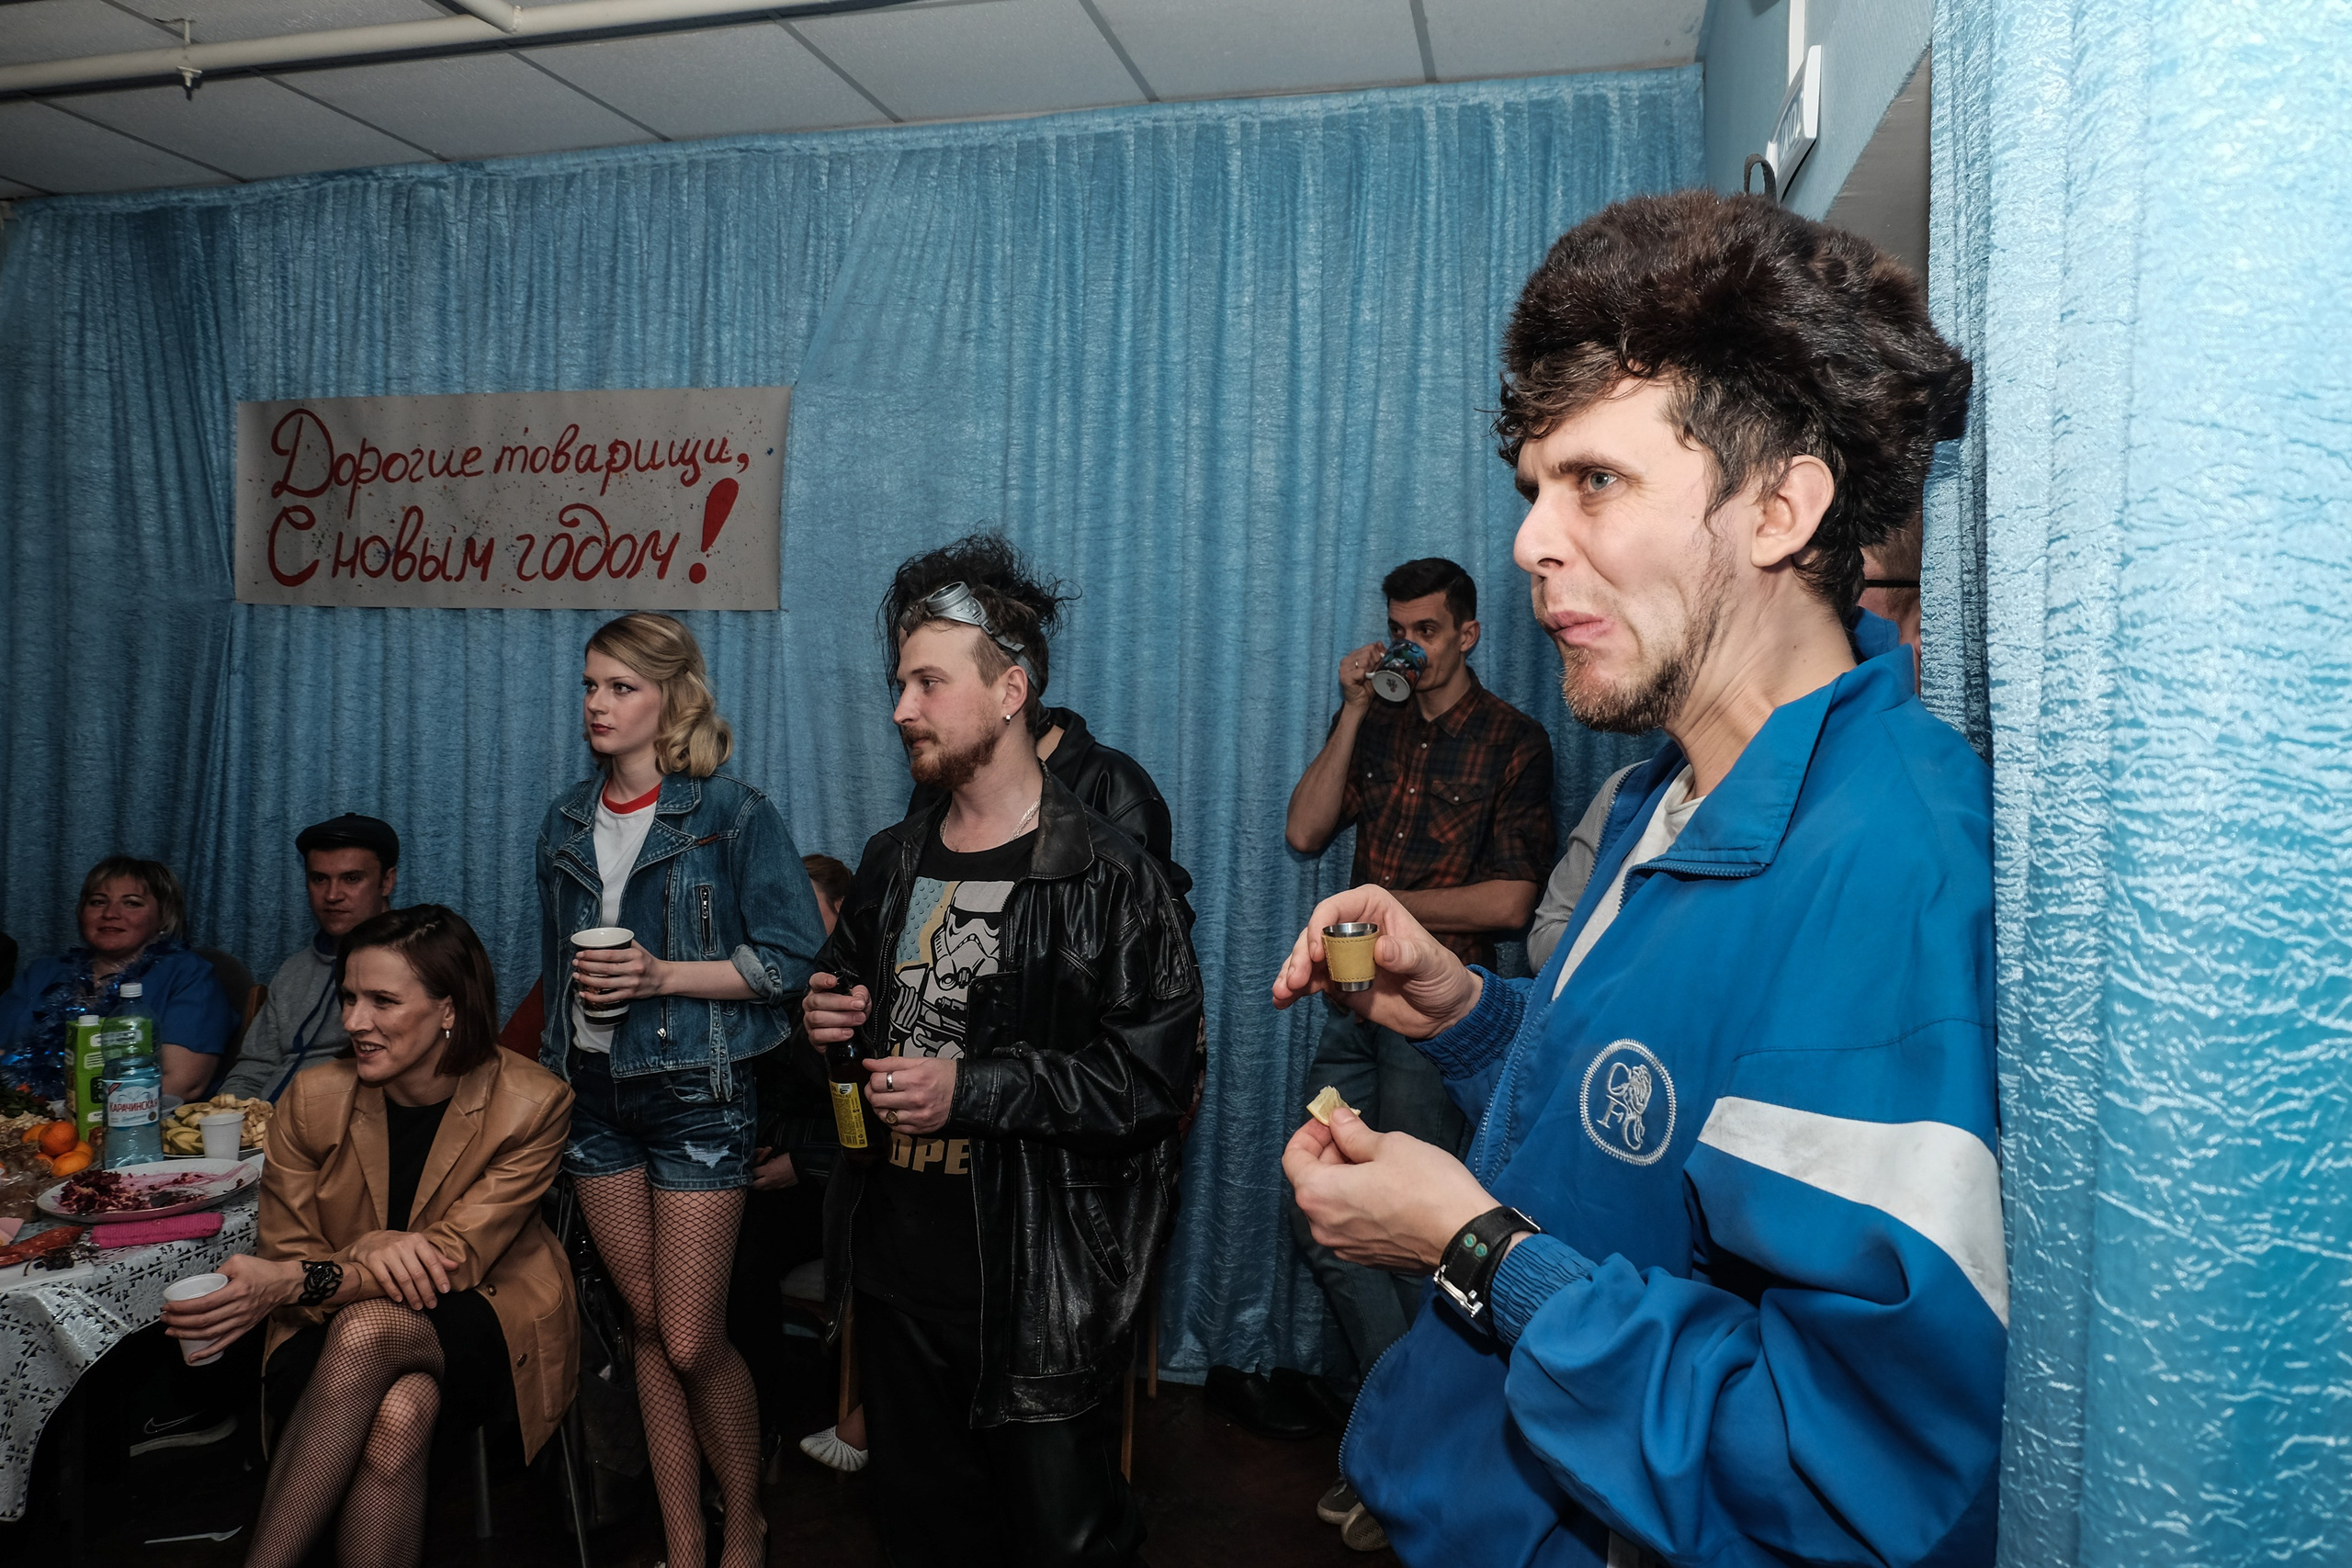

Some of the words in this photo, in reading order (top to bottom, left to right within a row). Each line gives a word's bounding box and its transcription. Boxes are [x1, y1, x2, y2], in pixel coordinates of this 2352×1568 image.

[271, 408, 484, 519] Дорогие
[493, 423, 750, 496] товарищи,
[267, 505, 322, 587] С
[332, 506, 494, 582] новым
[516, 477, 740, 584] годом!
